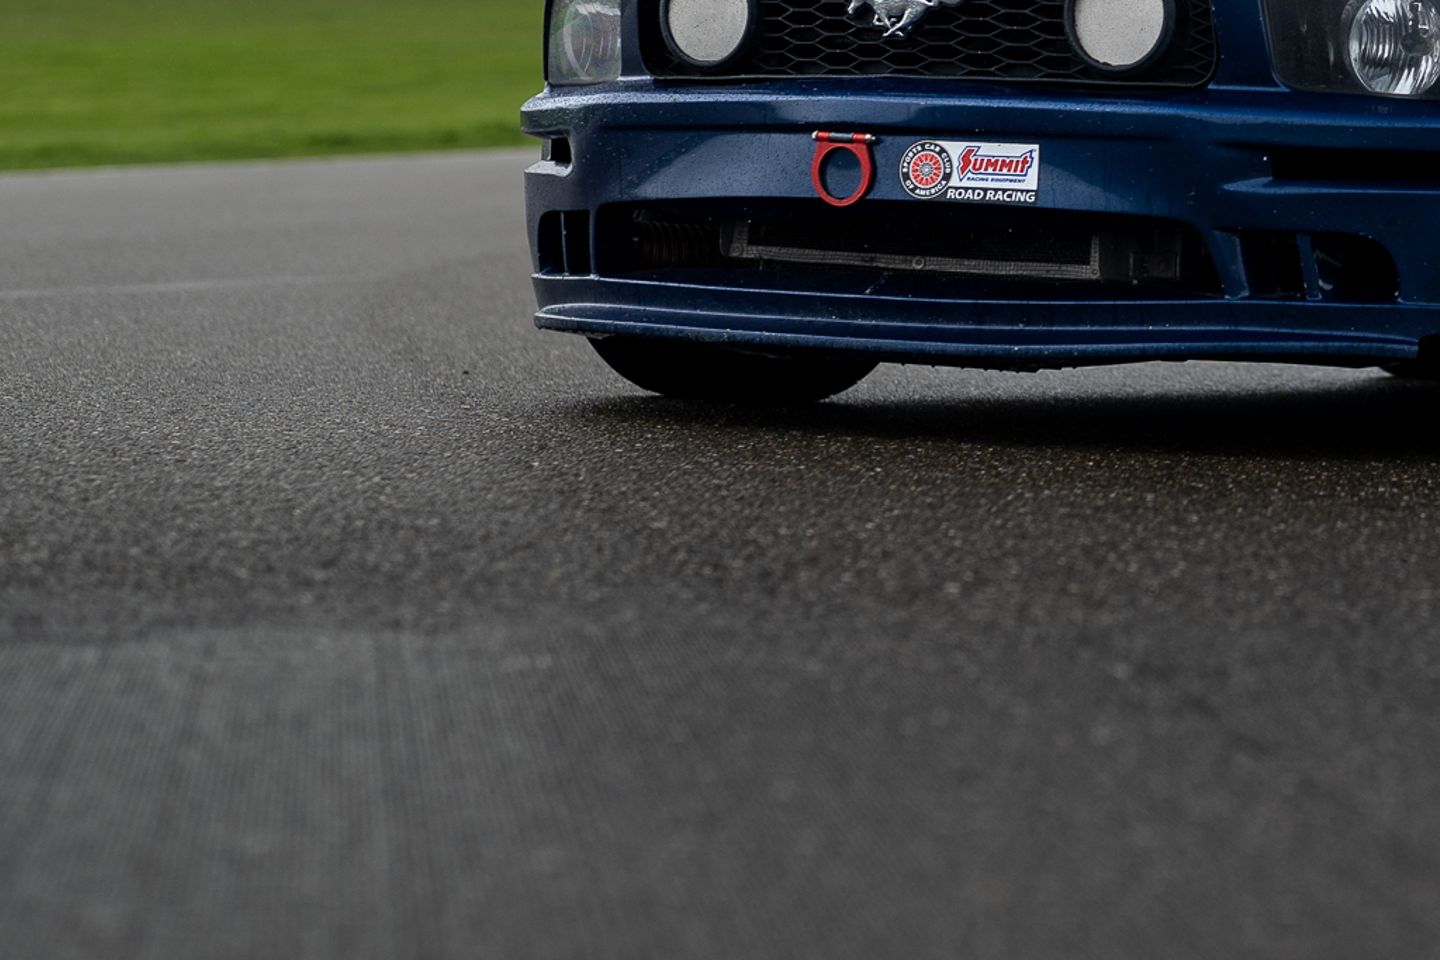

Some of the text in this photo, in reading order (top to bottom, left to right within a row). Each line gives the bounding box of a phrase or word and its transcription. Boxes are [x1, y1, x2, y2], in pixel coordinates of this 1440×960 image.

[924, 142, 941, 153] CAR
[941, 152, 952, 174] CLUB
[905, 179, 947, 196] OF AMERICA
[946, 188, 1037, 203] ROAD RACING
